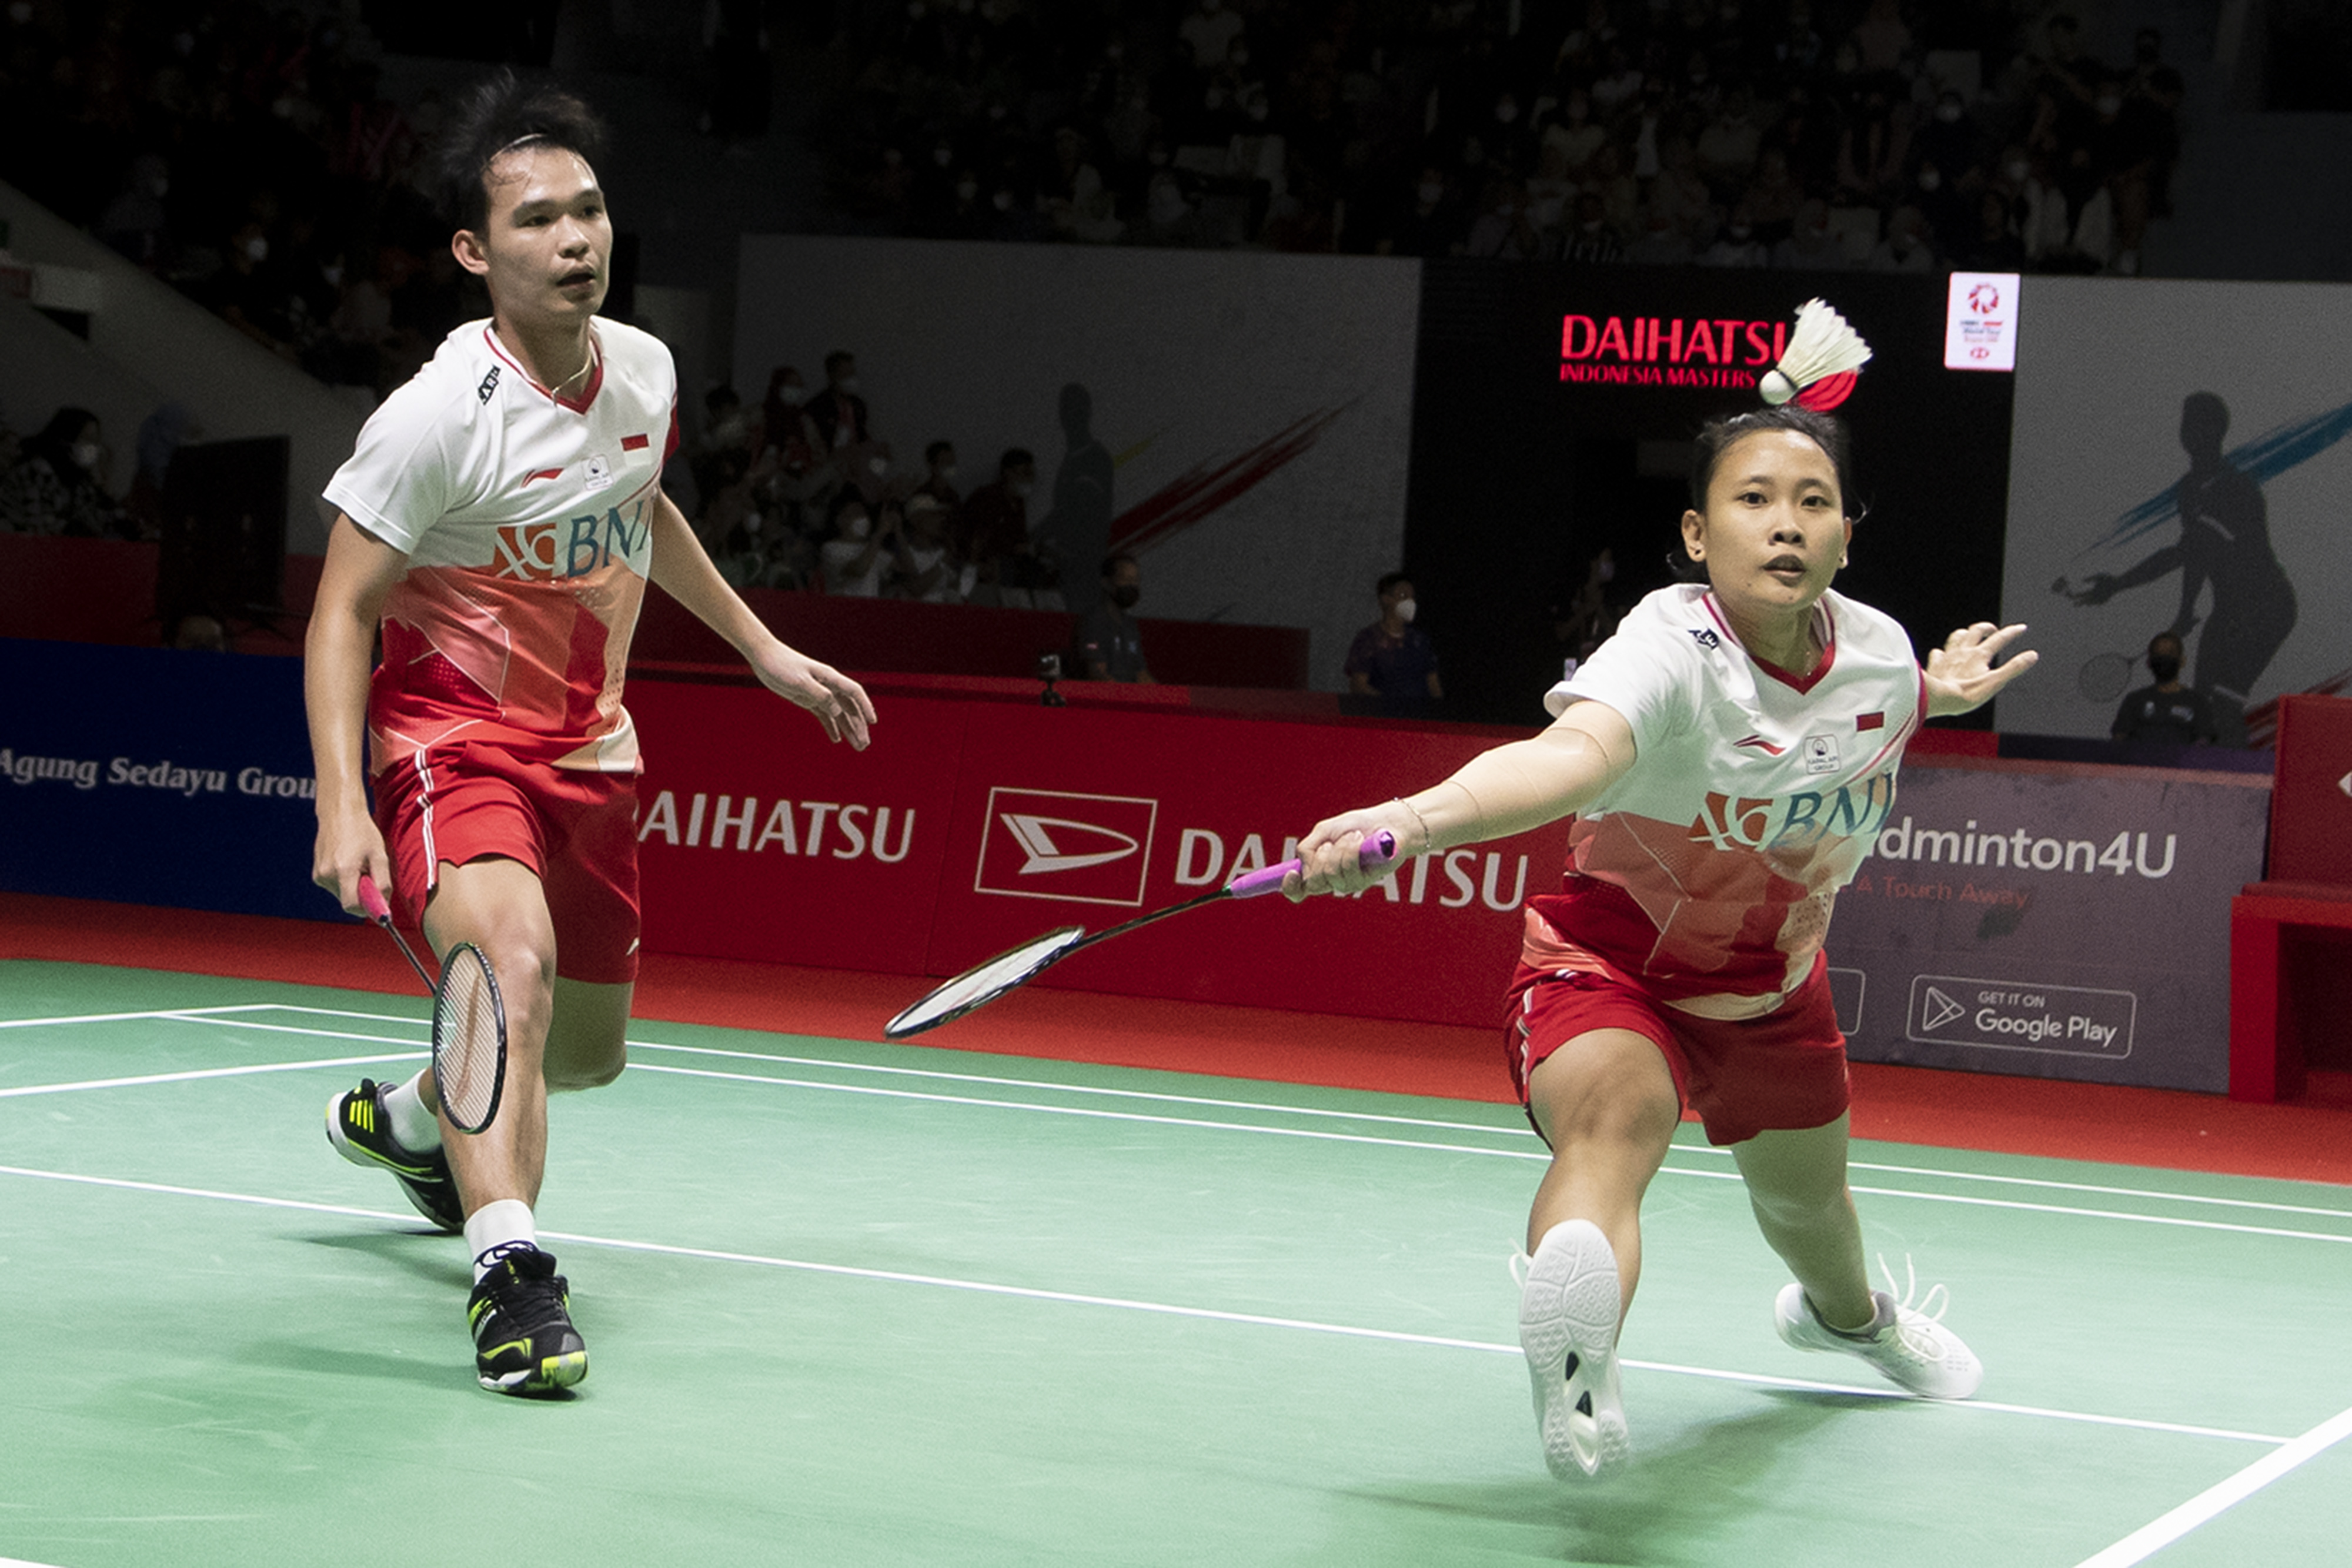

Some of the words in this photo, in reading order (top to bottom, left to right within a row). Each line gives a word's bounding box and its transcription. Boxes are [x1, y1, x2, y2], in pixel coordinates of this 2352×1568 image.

[1559, 363, 1663, 385] INDONESIA
[1666, 367, 1756, 389] MASTERS
[108, 757, 228, 797] Sedayu
[237, 766, 316, 799] Grou
[633, 790, 916, 863] AIHATSU
[1769, 771, 1893, 850] BNI
[1863, 815, 2176, 878] dminton4U
[1175, 828, 1528, 912] DATSU
[1883, 875, 1953, 901] Touch
[1959, 882, 2029, 910] Away
[1977, 991, 2006, 1005] GET
[2007, 993, 2021, 1006] IT
[2022, 995, 2046, 1008] ON
[1975, 1008, 2063, 1042] Google
[2067, 1015, 2118, 1048] Play
